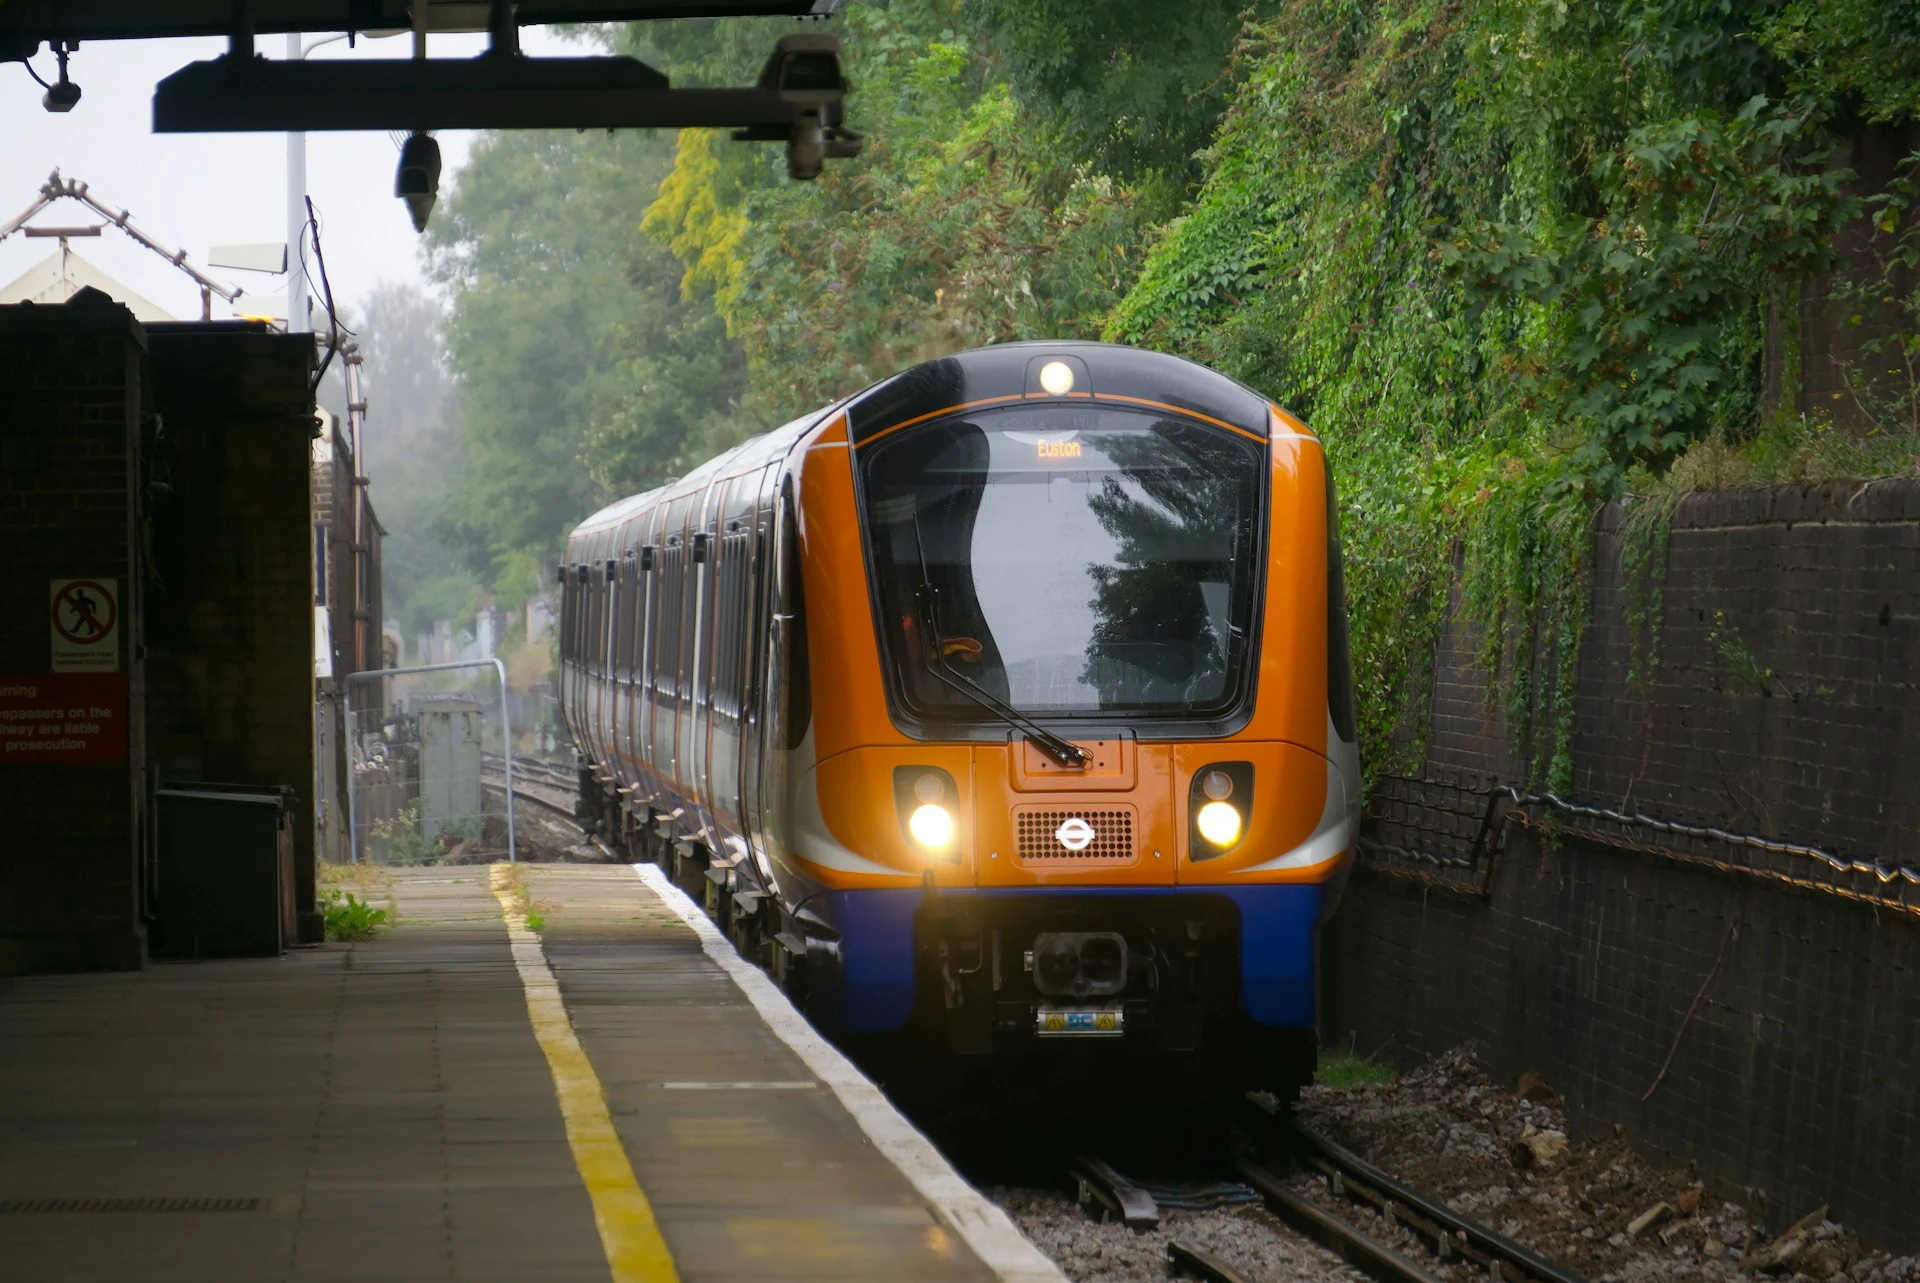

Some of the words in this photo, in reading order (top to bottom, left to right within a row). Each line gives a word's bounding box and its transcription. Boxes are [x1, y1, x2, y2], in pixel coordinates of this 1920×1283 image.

[1038, 438, 1081, 457] Euston
[0, 709, 64, 720] spassers
[68, 709, 85, 718] on
[89, 706, 112, 718] the
[38, 725, 60, 734] are
[65, 722, 100, 734] liable
[5, 739, 86, 752] prosecution
